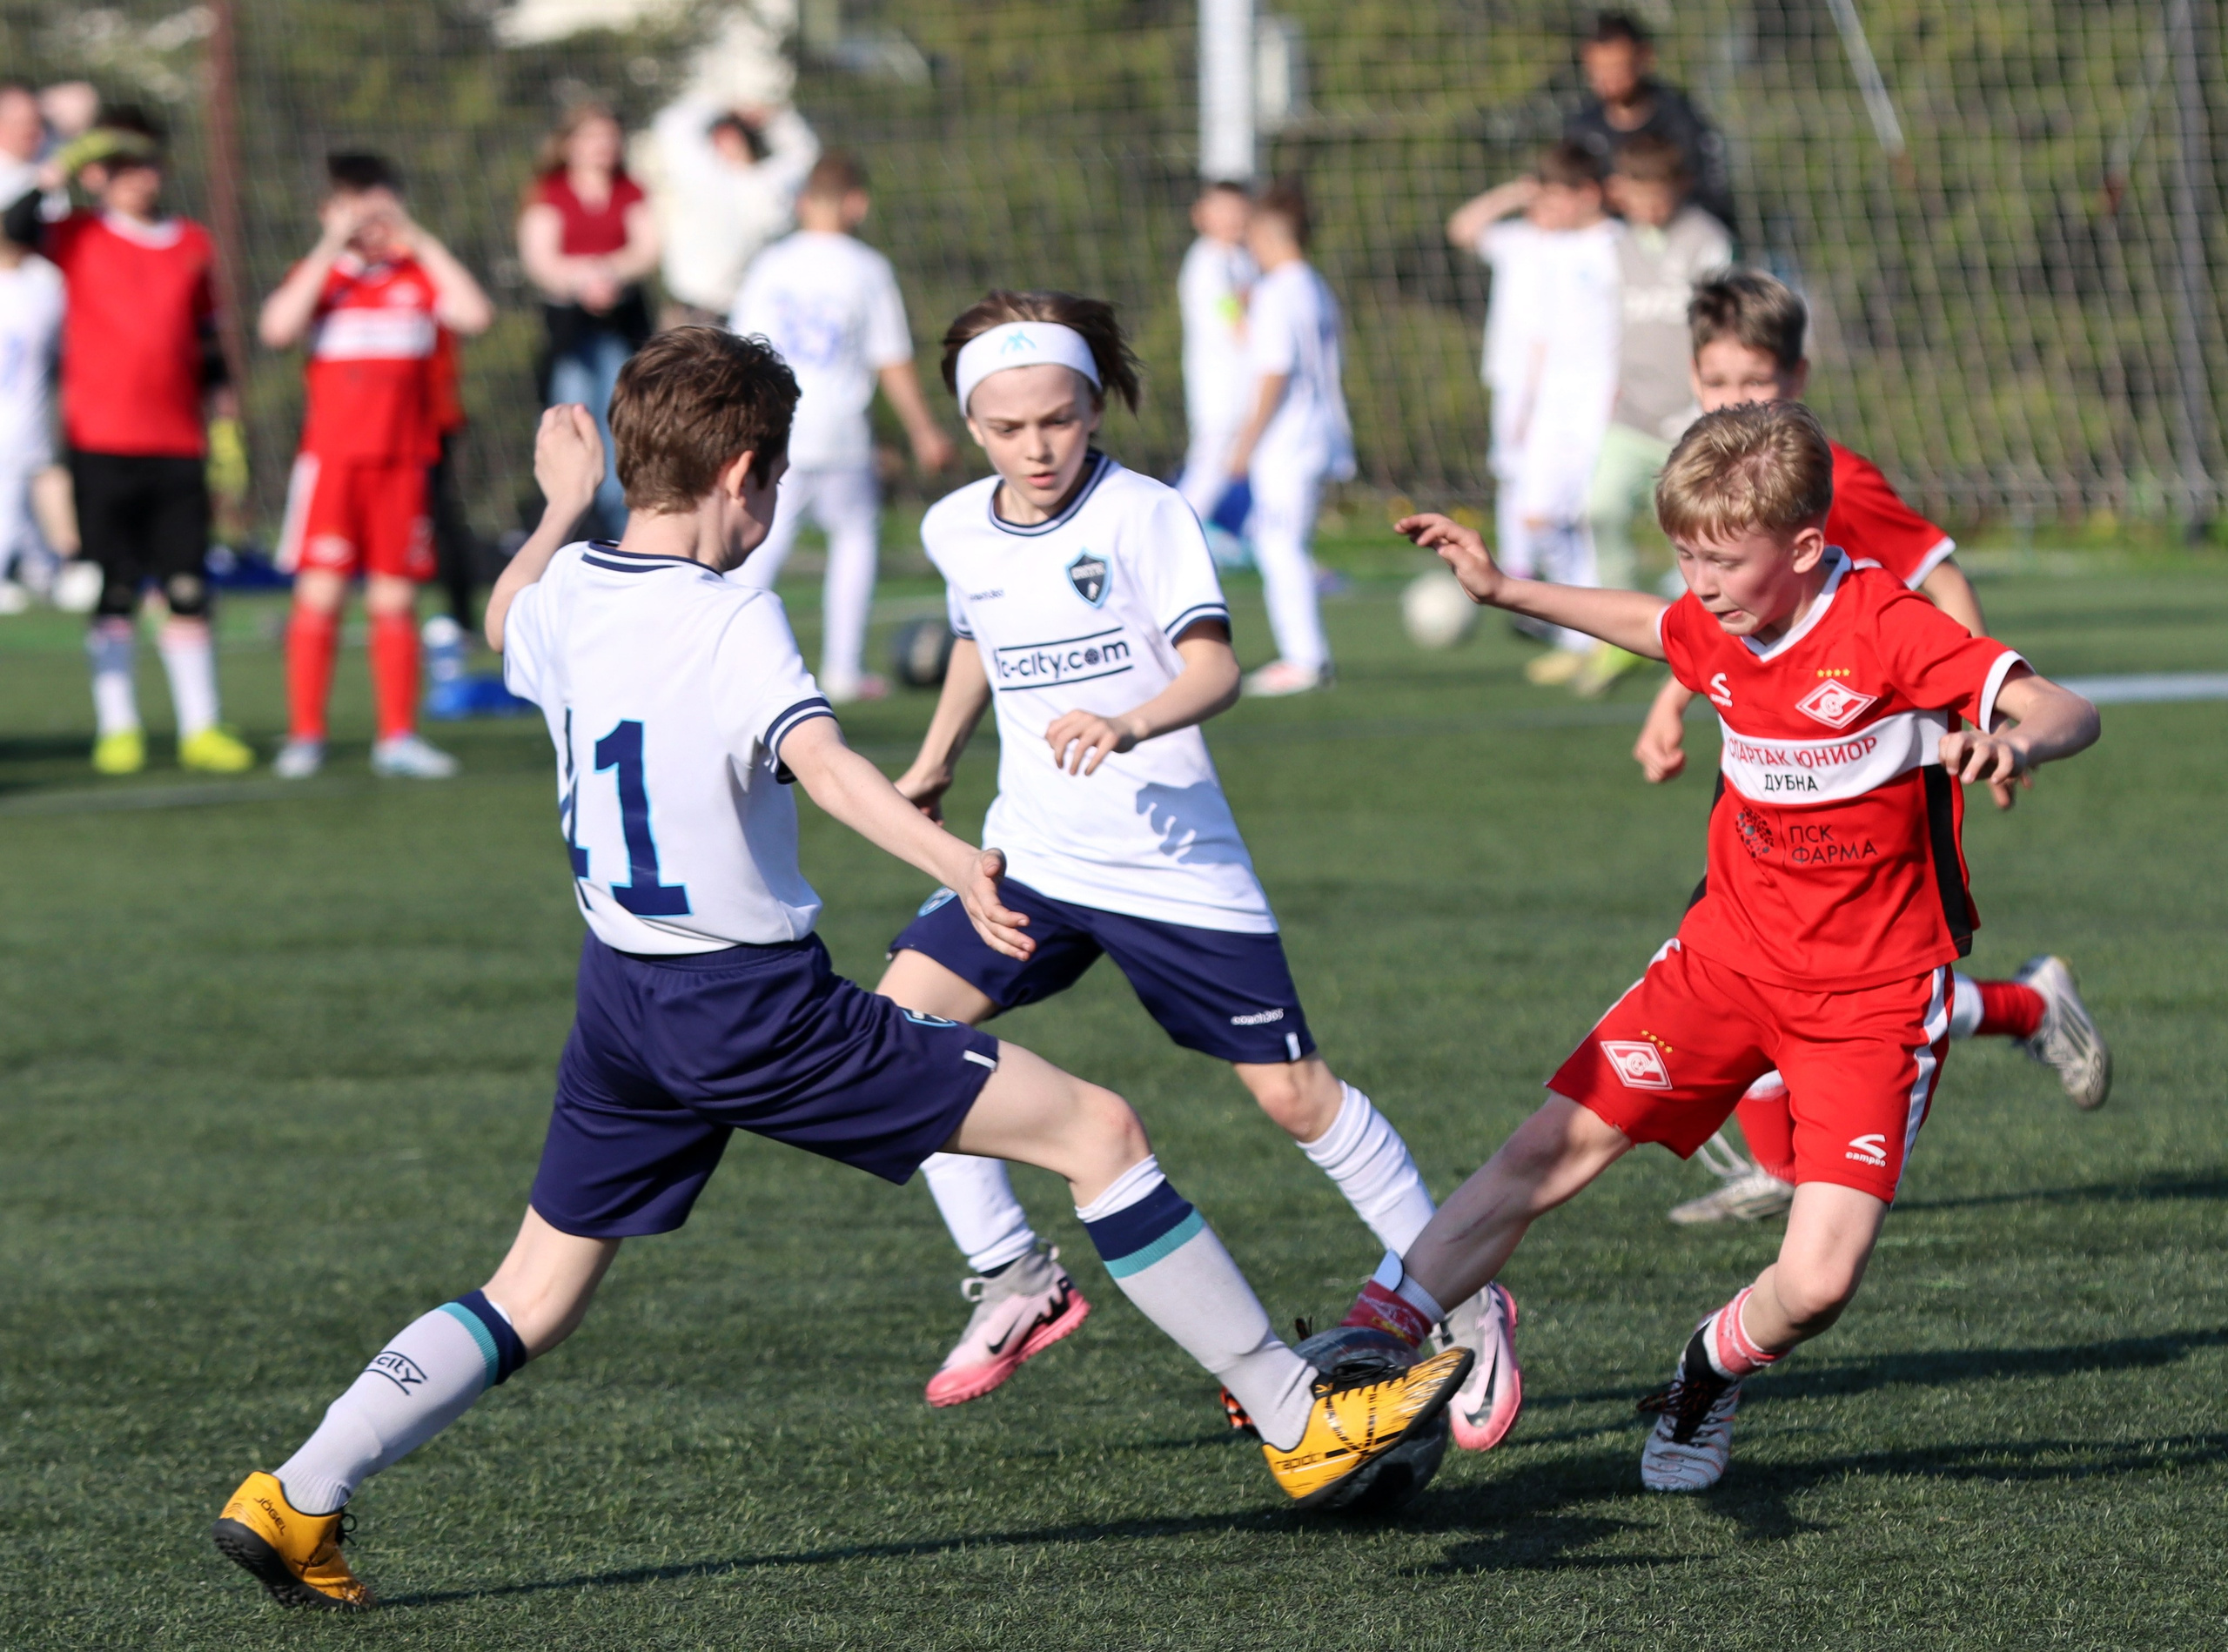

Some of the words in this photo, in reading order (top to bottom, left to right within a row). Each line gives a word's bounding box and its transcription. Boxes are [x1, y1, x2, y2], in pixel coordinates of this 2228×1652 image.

[1728, 737, 1793, 767] СПАРТАК
[1794, 735, 1877, 769] ЮНИОР
[1764, 774, 1819, 793] ДУБНА
[1789, 824, 1835, 844] ПСК
[1790, 841, 1879, 864] ФАРМА
[253, 1497, 286, 1537] JÖGEL
